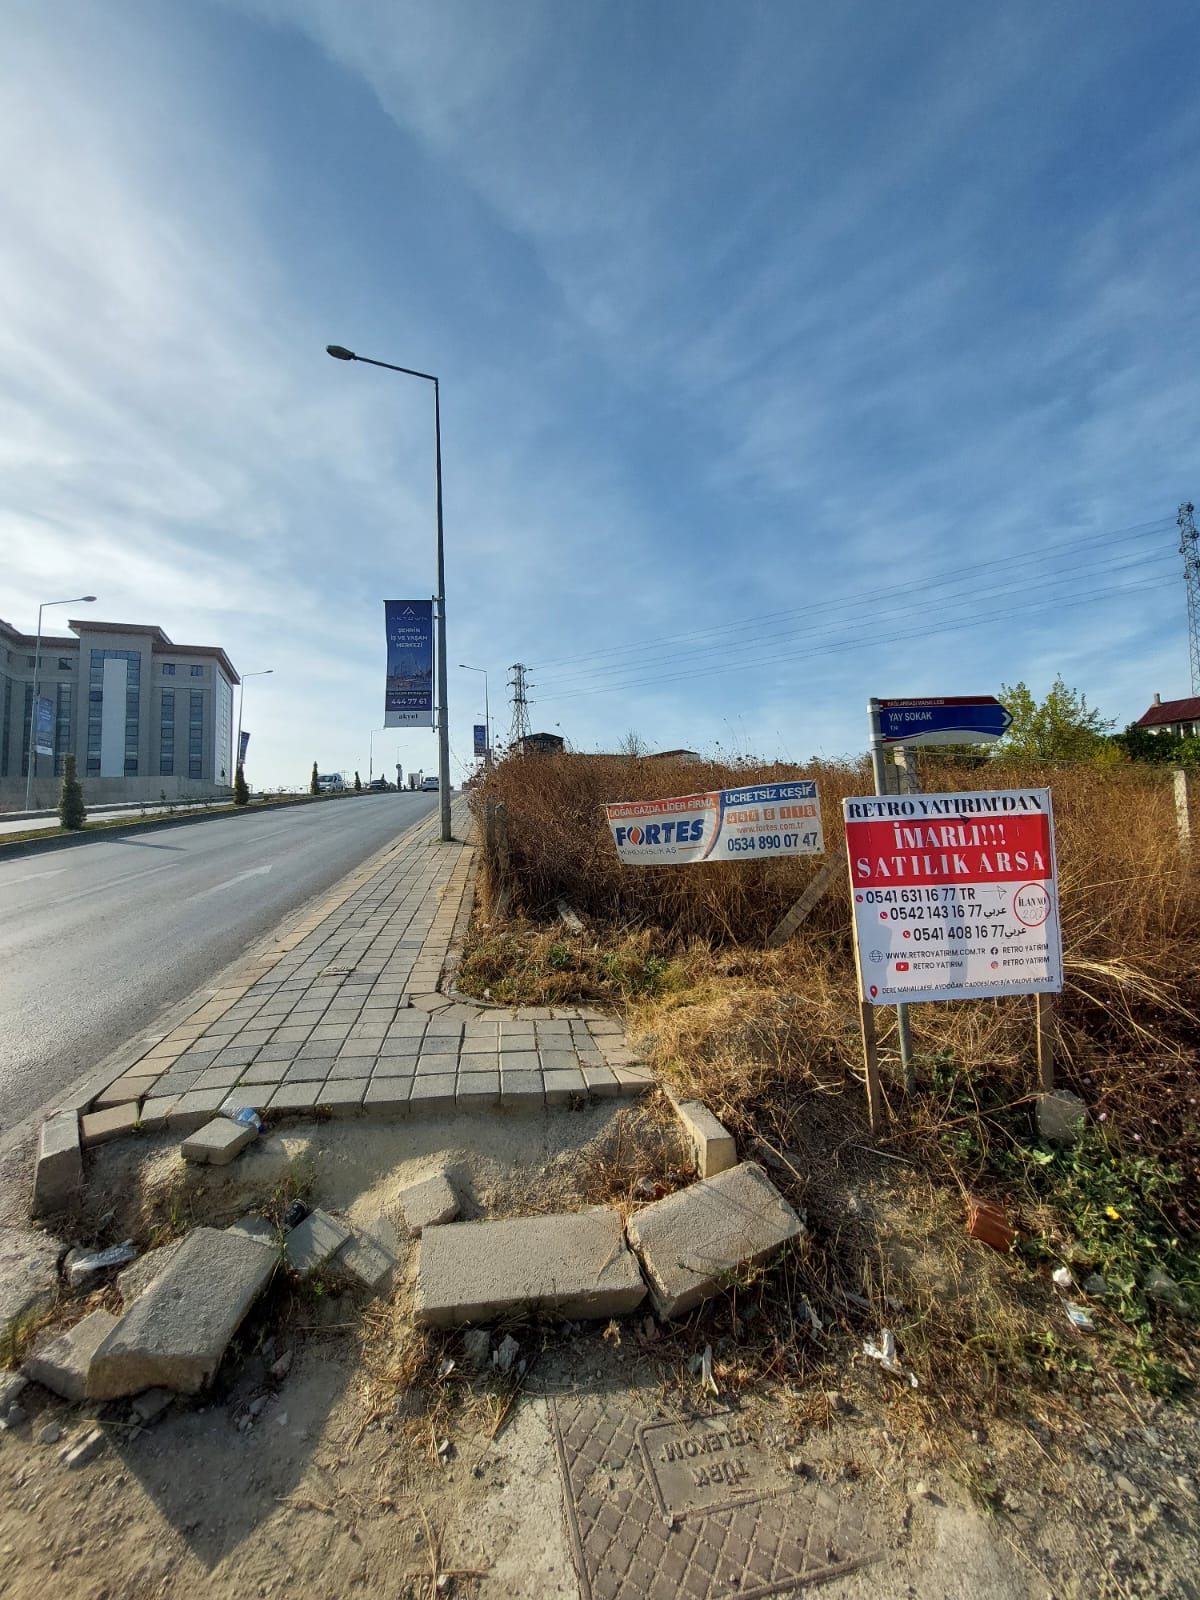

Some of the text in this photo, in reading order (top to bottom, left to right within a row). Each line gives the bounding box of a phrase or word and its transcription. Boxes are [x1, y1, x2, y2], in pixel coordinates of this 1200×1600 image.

[888, 711, 932, 722] YAY SOKAK
[725, 784, 812, 804] ÜCRETSİZ KEŞİF
[662, 802, 686, 812] LİDER
[688, 798, 714, 809] FİRMA
[782, 806, 815, 818] 118
[848, 795, 1042, 819] RETRO YATIRIM'DAN
[615, 818, 705, 847] FORTES
[736, 822, 804, 834] www.fortes.com.tr
[892, 822, 1007, 850] İMARLI!!!
[728, 832, 818, 852] 0534 890 07 47
[856, 850, 1046, 879] SATILIK ARSA
[866, 887, 976, 904] 0541 631 16 77 TR
[1018, 896, 1036, 906] İLAN
[890, 904, 1008, 921] 0542 143 16 77 عربي
[913, 924, 1027, 942] 0541 408 16 77 عربي
[885, 948, 986, 961] WWW.RETROYATIRIM.COM.TR
[1002, 944, 1049, 954] RETRO YATIRIM
[912, 960, 963, 970] RETRO YATIRIM
[1002, 956, 1050, 967] RETRO YATIRIM
[692, 1456, 750, 1487] TÜRK
